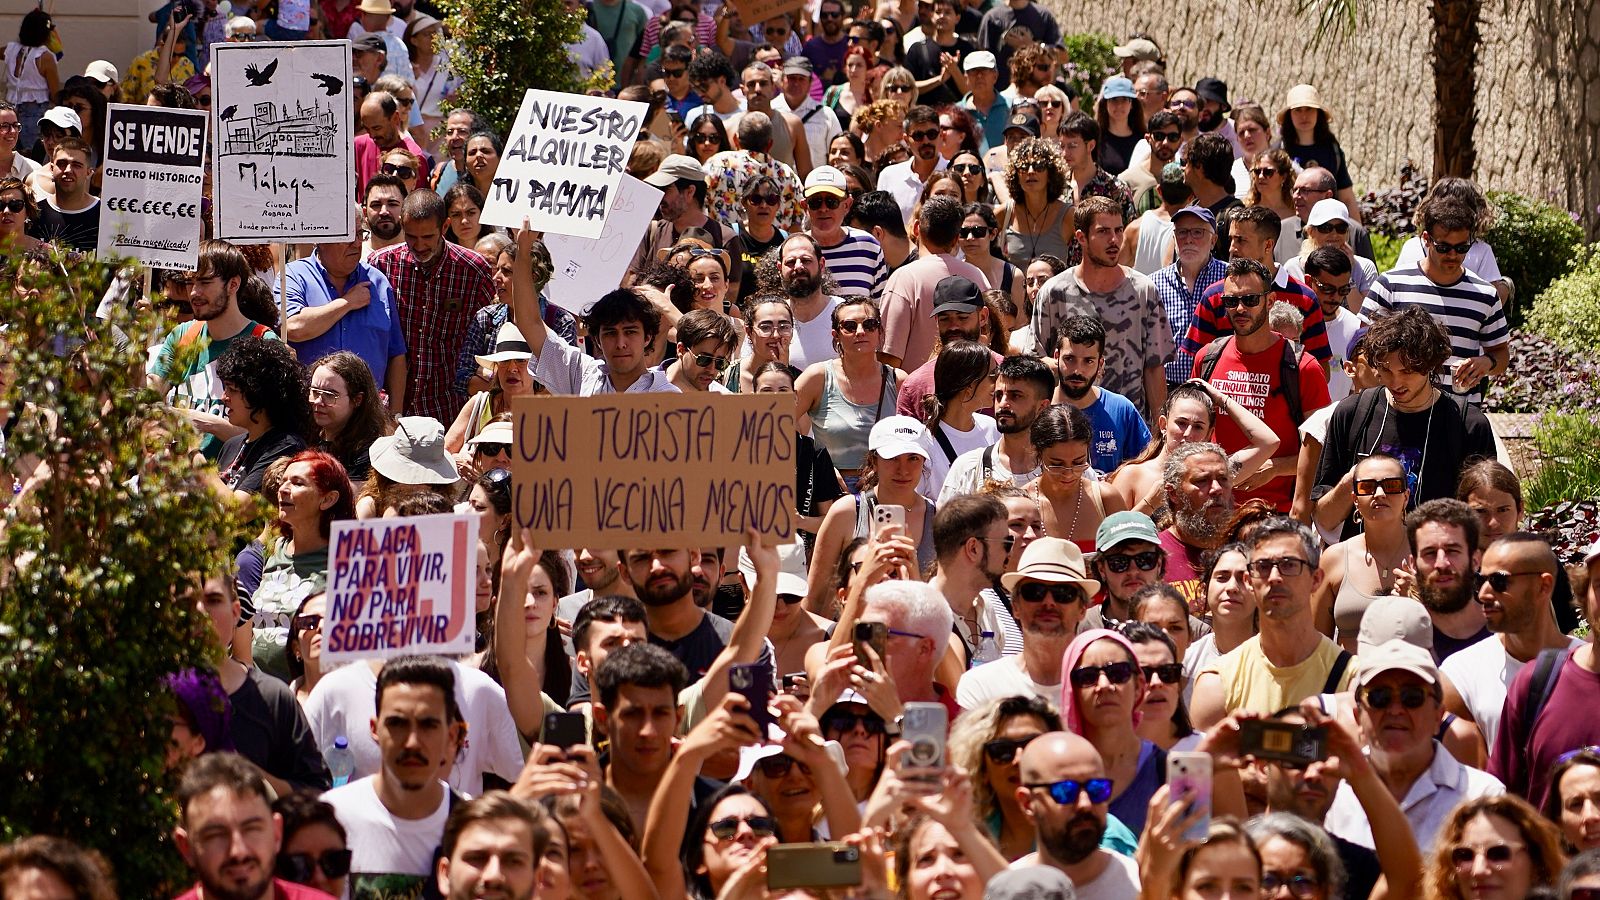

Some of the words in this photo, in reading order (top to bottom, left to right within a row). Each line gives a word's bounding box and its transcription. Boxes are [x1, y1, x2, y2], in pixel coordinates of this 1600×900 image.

[113, 121, 137, 151] SE
[141, 123, 201, 157] VENDE
[529, 100, 639, 142] NUESTRO
[506, 133, 625, 175] ALQUILER
[106, 168, 147, 180] CENTRO
[149, 171, 201, 184] HISTORICO
[238, 161, 315, 214] Málaga
[107, 197, 196, 219] €€€.€€€,€€
[493, 177, 520, 204] TU
[528, 179, 609, 221] PAGUITA
[239, 220, 259, 230] donde
[290, 222, 296, 231] el
[300, 221, 330, 231] turismo
[1222, 382, 1268, 395] INQUILINAS
[1228, 370, 1270, 384] SINDICATO
[518, 408, 568, 463] UN
[592, 403, 716, 464] TURISTA
[731, 401, 794, 465] MÁS
[515, 477, 573, 533] UNA
[594, 476, 685, 533] VECINA
[702, 477, 794, 540] MENOS
[335, 521, 416, 559] MÁLAGA
[334, 557, 388, 590] PARA
[397, 552, 447, 584] VIVIR,
[331, 591, 364, 622] NO
[368, 586, 416, 620] PARA
[328, 614, 449, 653] SOBREVIVIR
